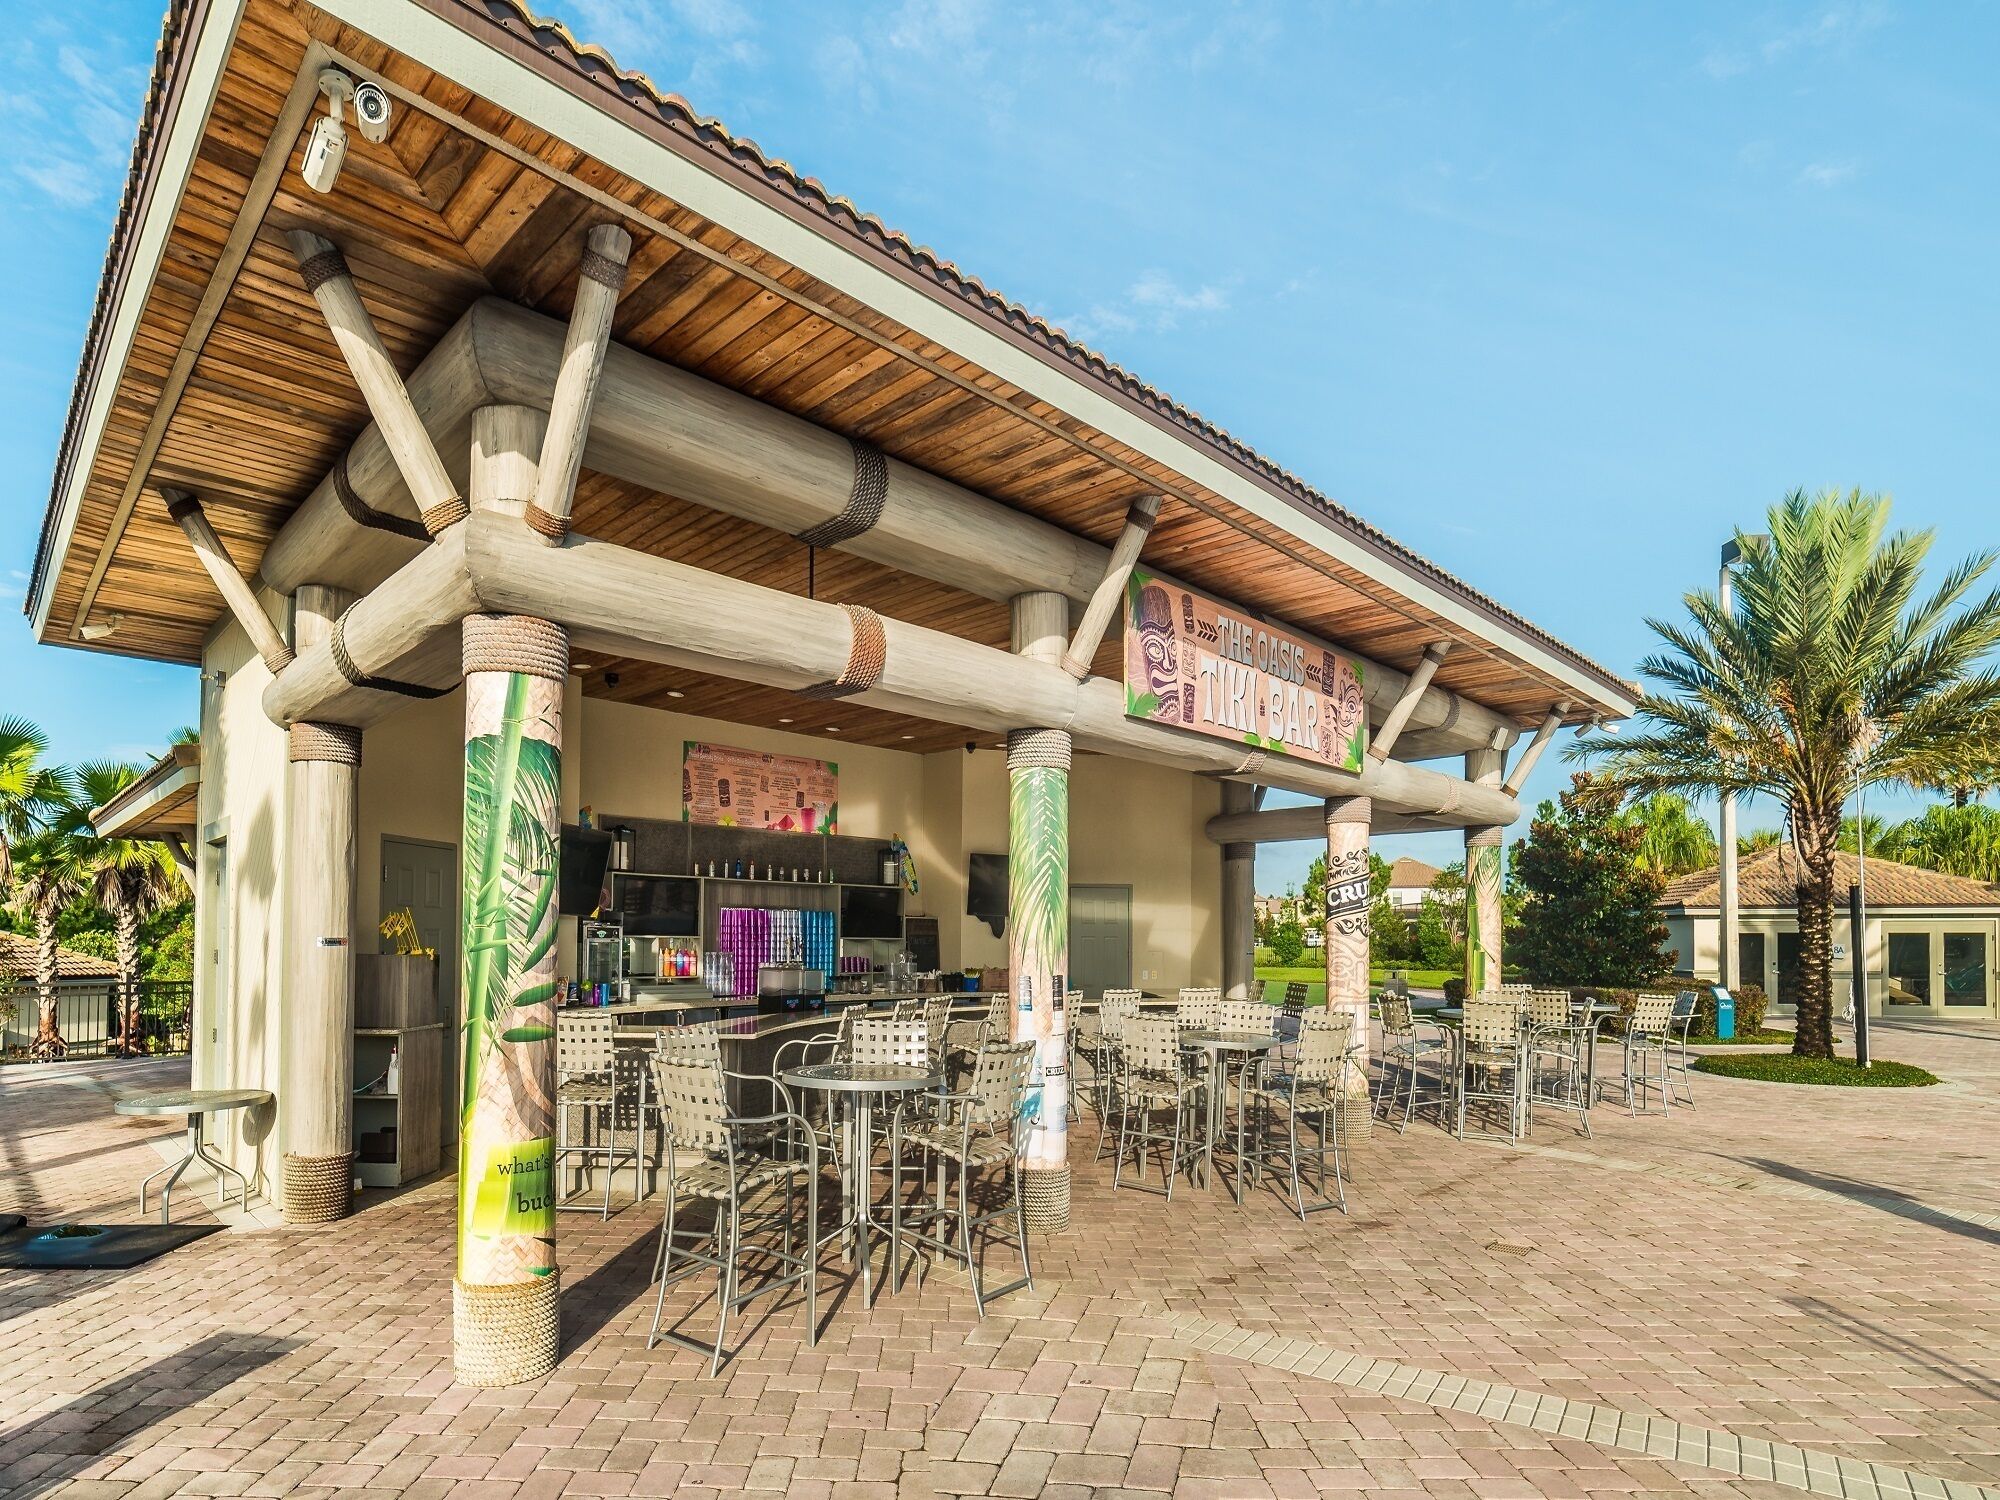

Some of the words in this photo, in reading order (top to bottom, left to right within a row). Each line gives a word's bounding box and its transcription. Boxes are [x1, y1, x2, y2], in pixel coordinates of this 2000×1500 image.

[1216, 614, 1254, 668] THE
[1257, 630, 1305, 687] OASIS
[1200, 654, 1258, 736] TIKI
[1268, 678, 1320, 754] BAR
[497, 1153, 551, 1176] what's
